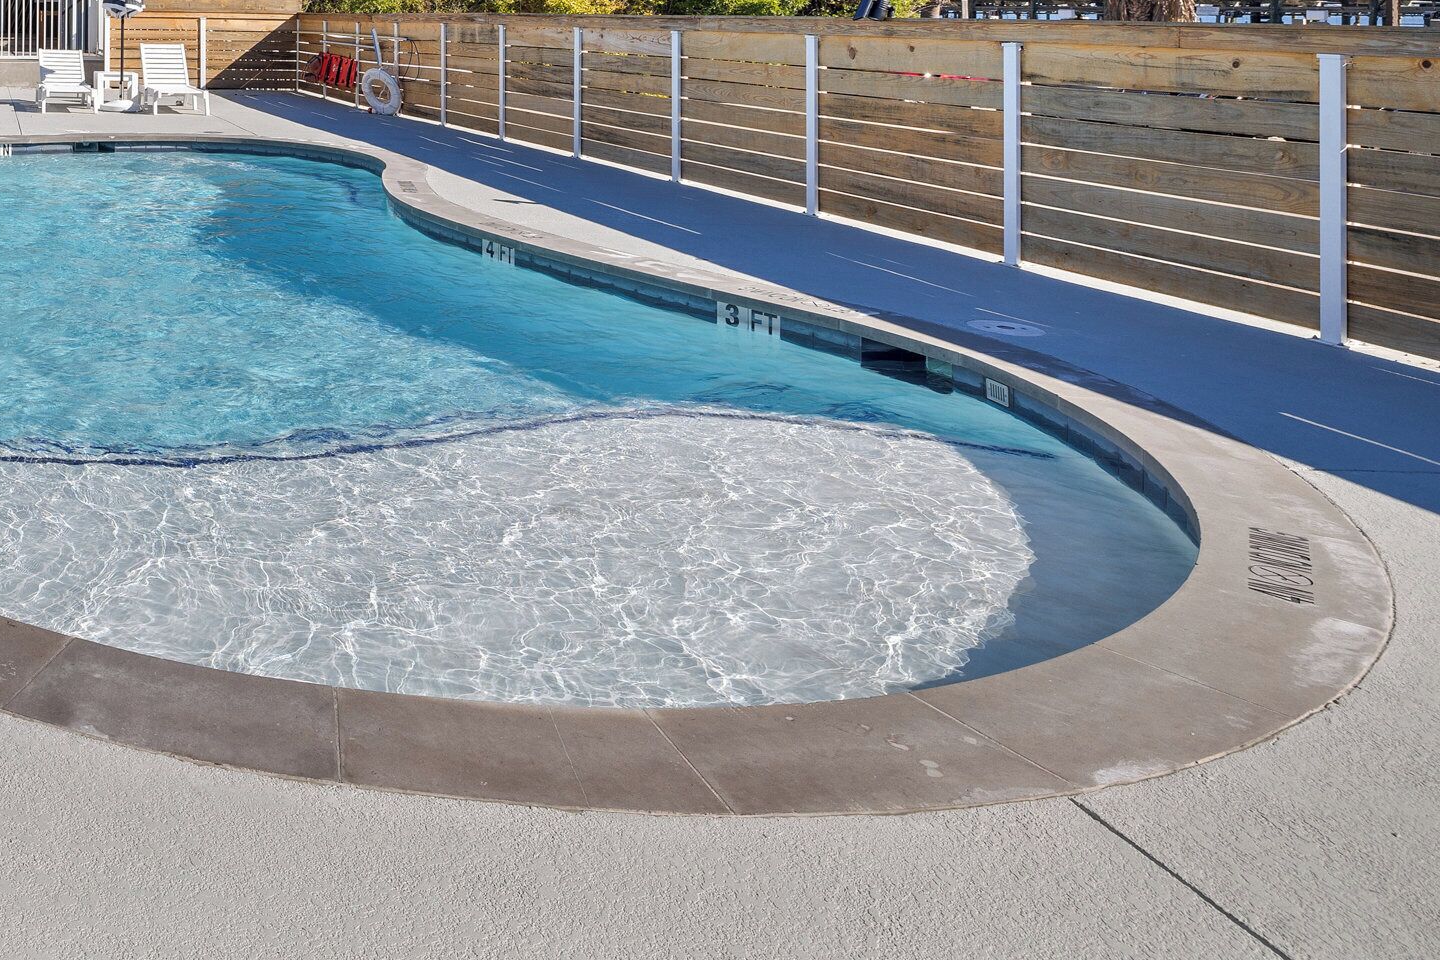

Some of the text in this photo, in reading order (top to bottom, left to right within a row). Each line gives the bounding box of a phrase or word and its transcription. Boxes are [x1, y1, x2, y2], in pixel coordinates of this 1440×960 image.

[486, 241, 514, 264] 4 FT
[725, 303, 778, 336] 3 FT
